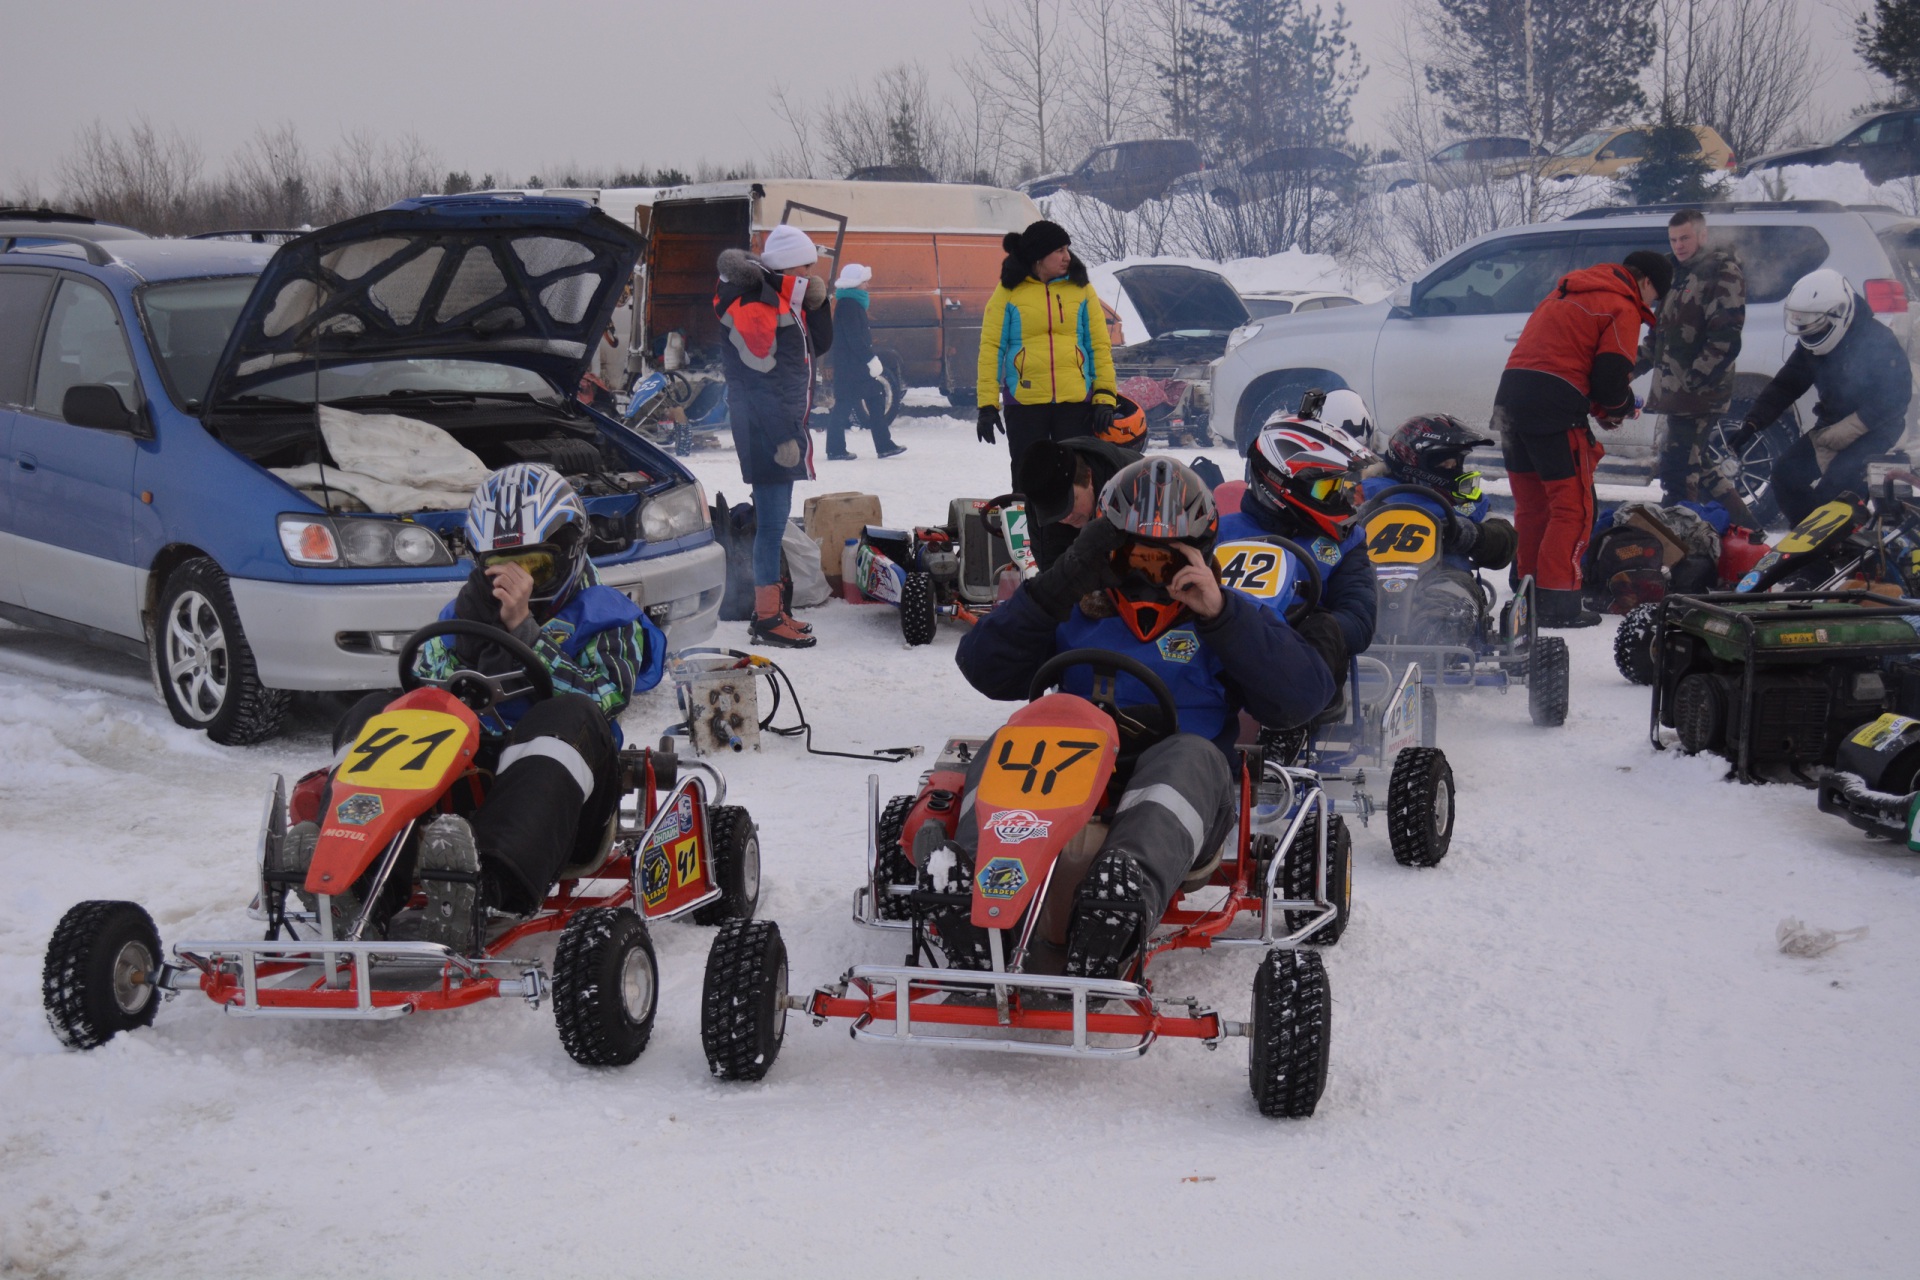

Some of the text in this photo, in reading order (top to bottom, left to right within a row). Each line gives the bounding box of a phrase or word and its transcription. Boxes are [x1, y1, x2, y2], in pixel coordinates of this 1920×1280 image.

[1010, 513, 1031, 541] 4
[1368, 523, 1431, 556] 46
[1791, 510, 1848, 546] 44
[1221, 552, 1276, 589] 42
[1389, 706, 1402, 738] 42
[348, 728, 456, 773] 41
[998, 740, 1100, 796] 47
[322, 828, 366, 841] MOTUL
[678, 841, 696, 884] 41
[646, 885, 667, 902] LEADER
